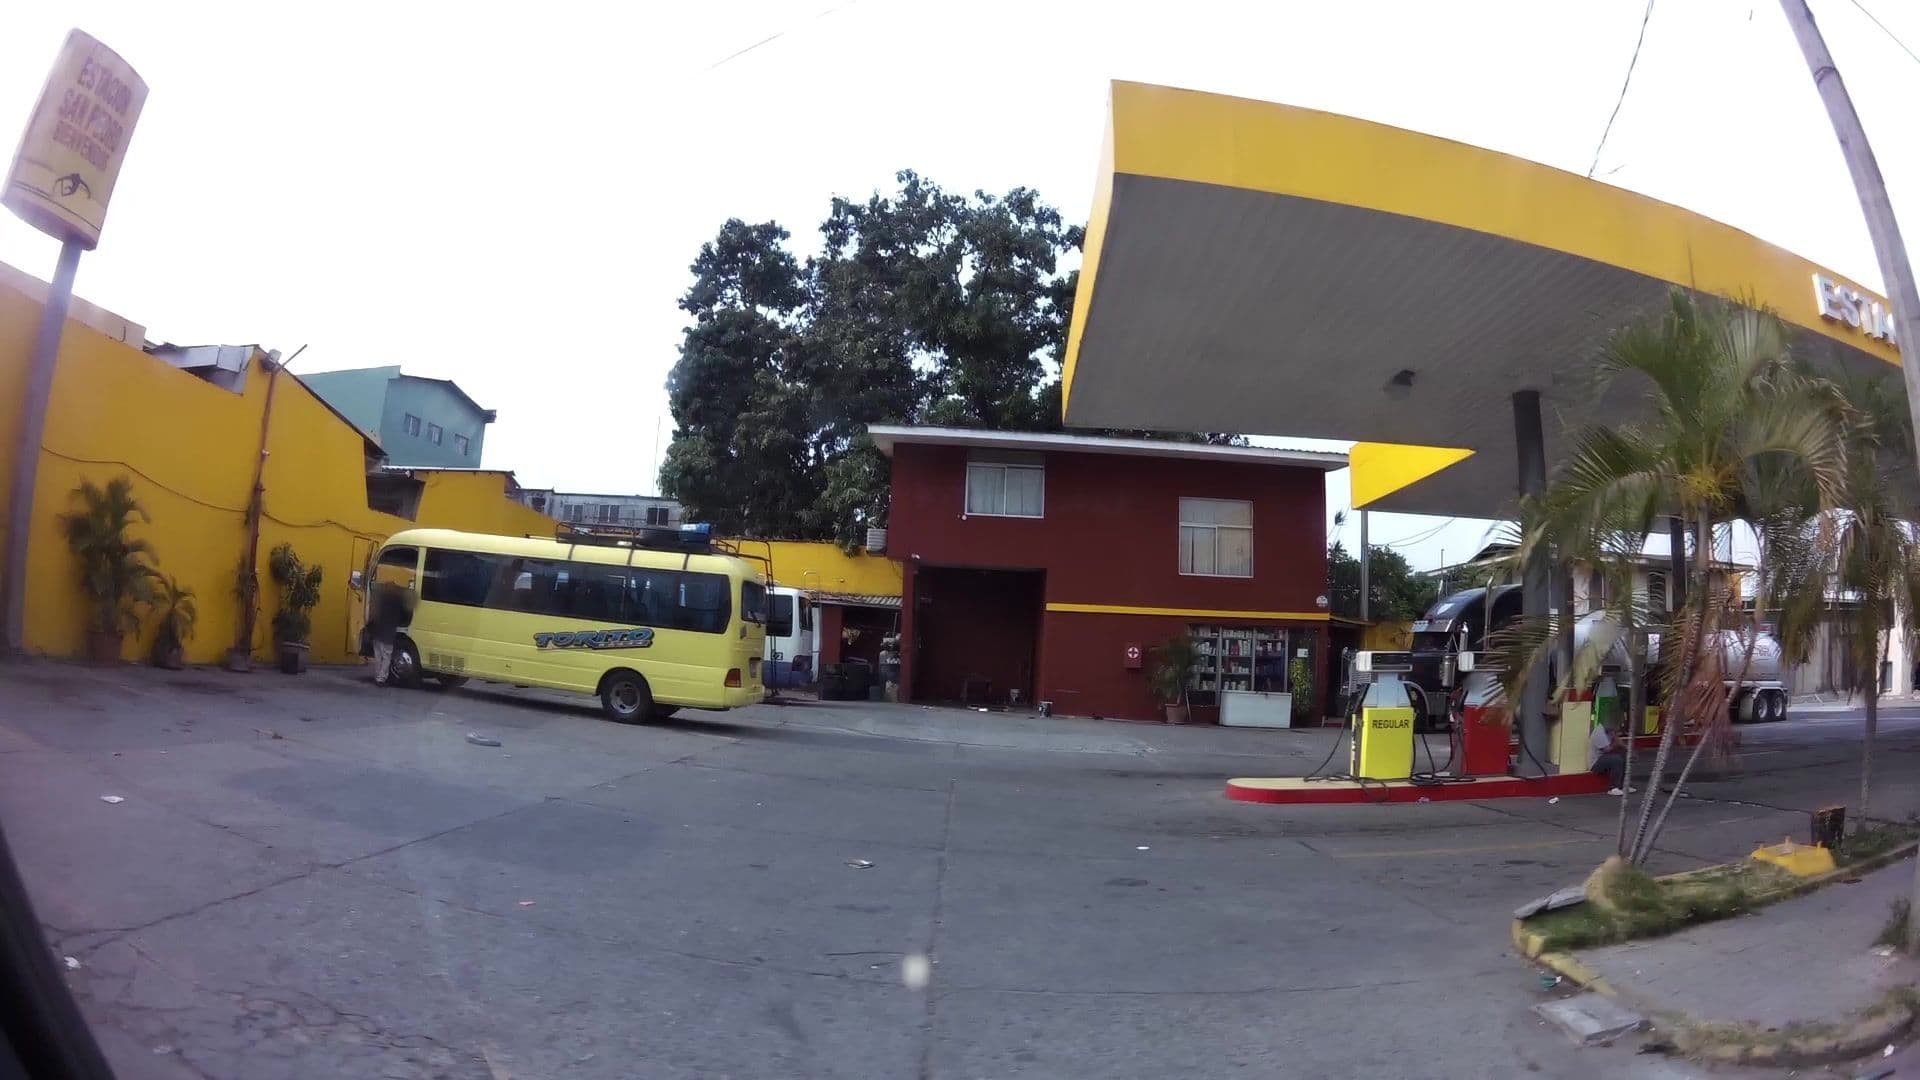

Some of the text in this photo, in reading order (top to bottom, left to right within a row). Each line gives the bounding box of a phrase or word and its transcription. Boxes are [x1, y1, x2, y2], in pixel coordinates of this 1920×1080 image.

[1811, 272, 1897, 345] ESTA
[533, 628, 655, 649] TORITO
[1372, 719, 1410, 729] REGULAR
